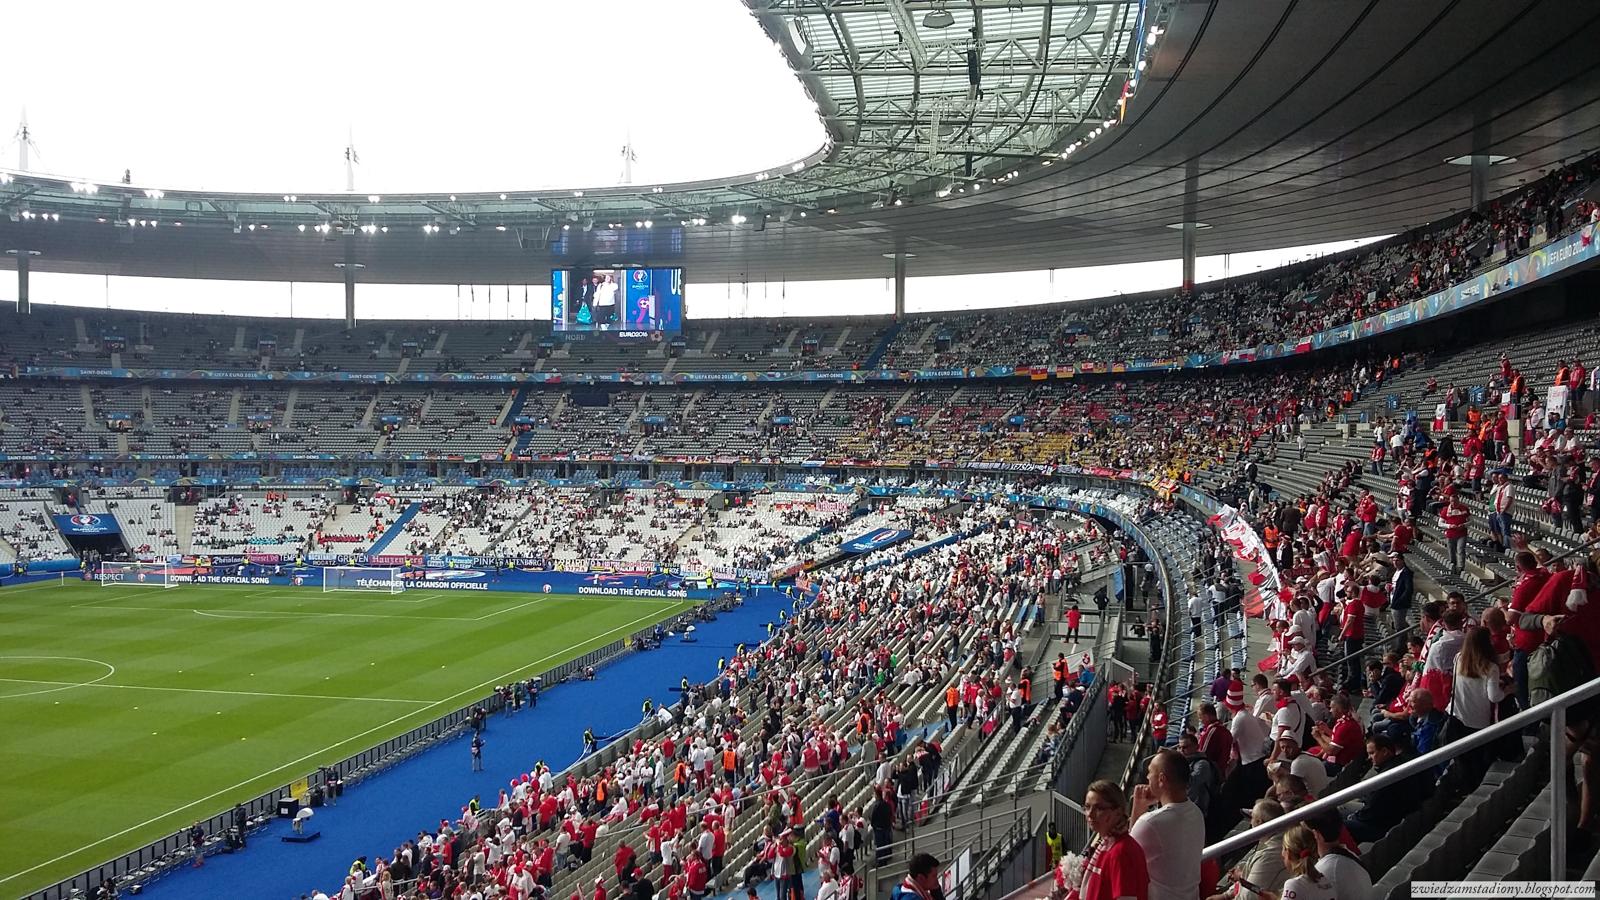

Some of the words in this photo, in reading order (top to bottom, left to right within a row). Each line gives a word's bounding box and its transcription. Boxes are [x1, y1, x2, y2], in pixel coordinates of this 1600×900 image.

[94, 573, 124, 581] RESPECT
[416, 580, 449, 589] CHANSON
[451, 581, 488, 590] OFFICIELLE
[578, 586, 618, 594] DOWNLOAD
[635, 588, 666, 597] OFFICIAL
[667, 590, 687, 598] SONG
